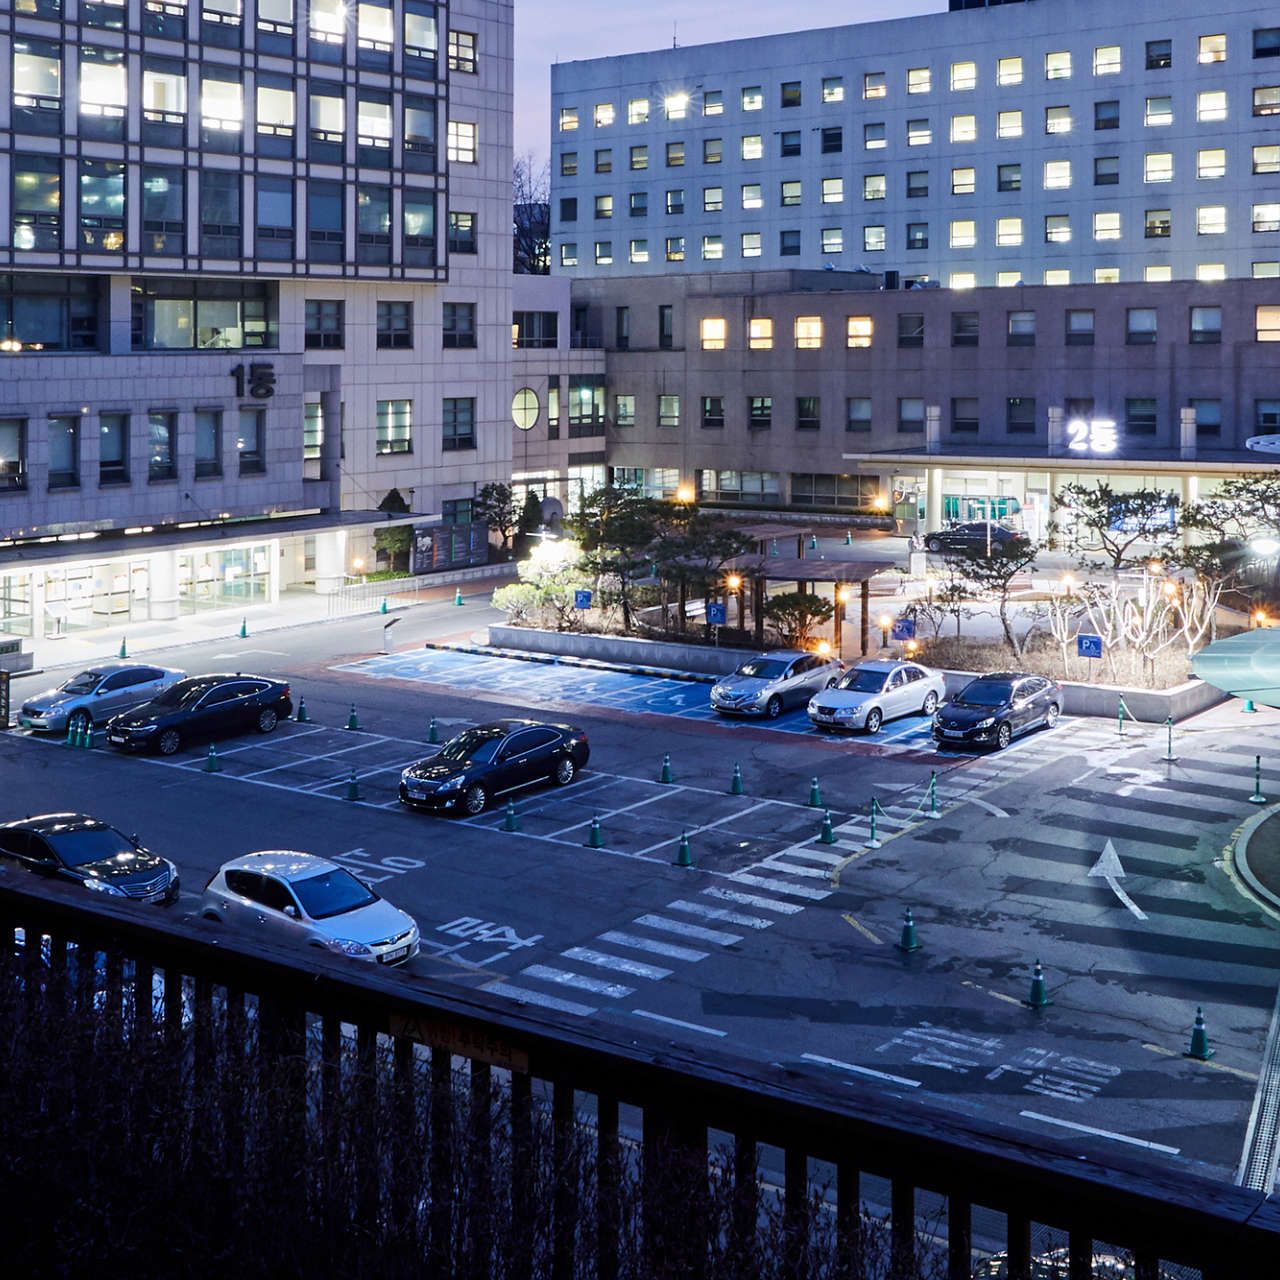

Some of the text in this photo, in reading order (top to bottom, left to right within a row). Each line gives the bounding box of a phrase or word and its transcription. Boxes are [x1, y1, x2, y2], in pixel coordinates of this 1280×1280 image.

[230, 363, 277, 399] 1동
[1067, 419, 1118, 453] 2동
[1082, 639, 1090, 650] P
[419, 916, 545, 969] 출구
